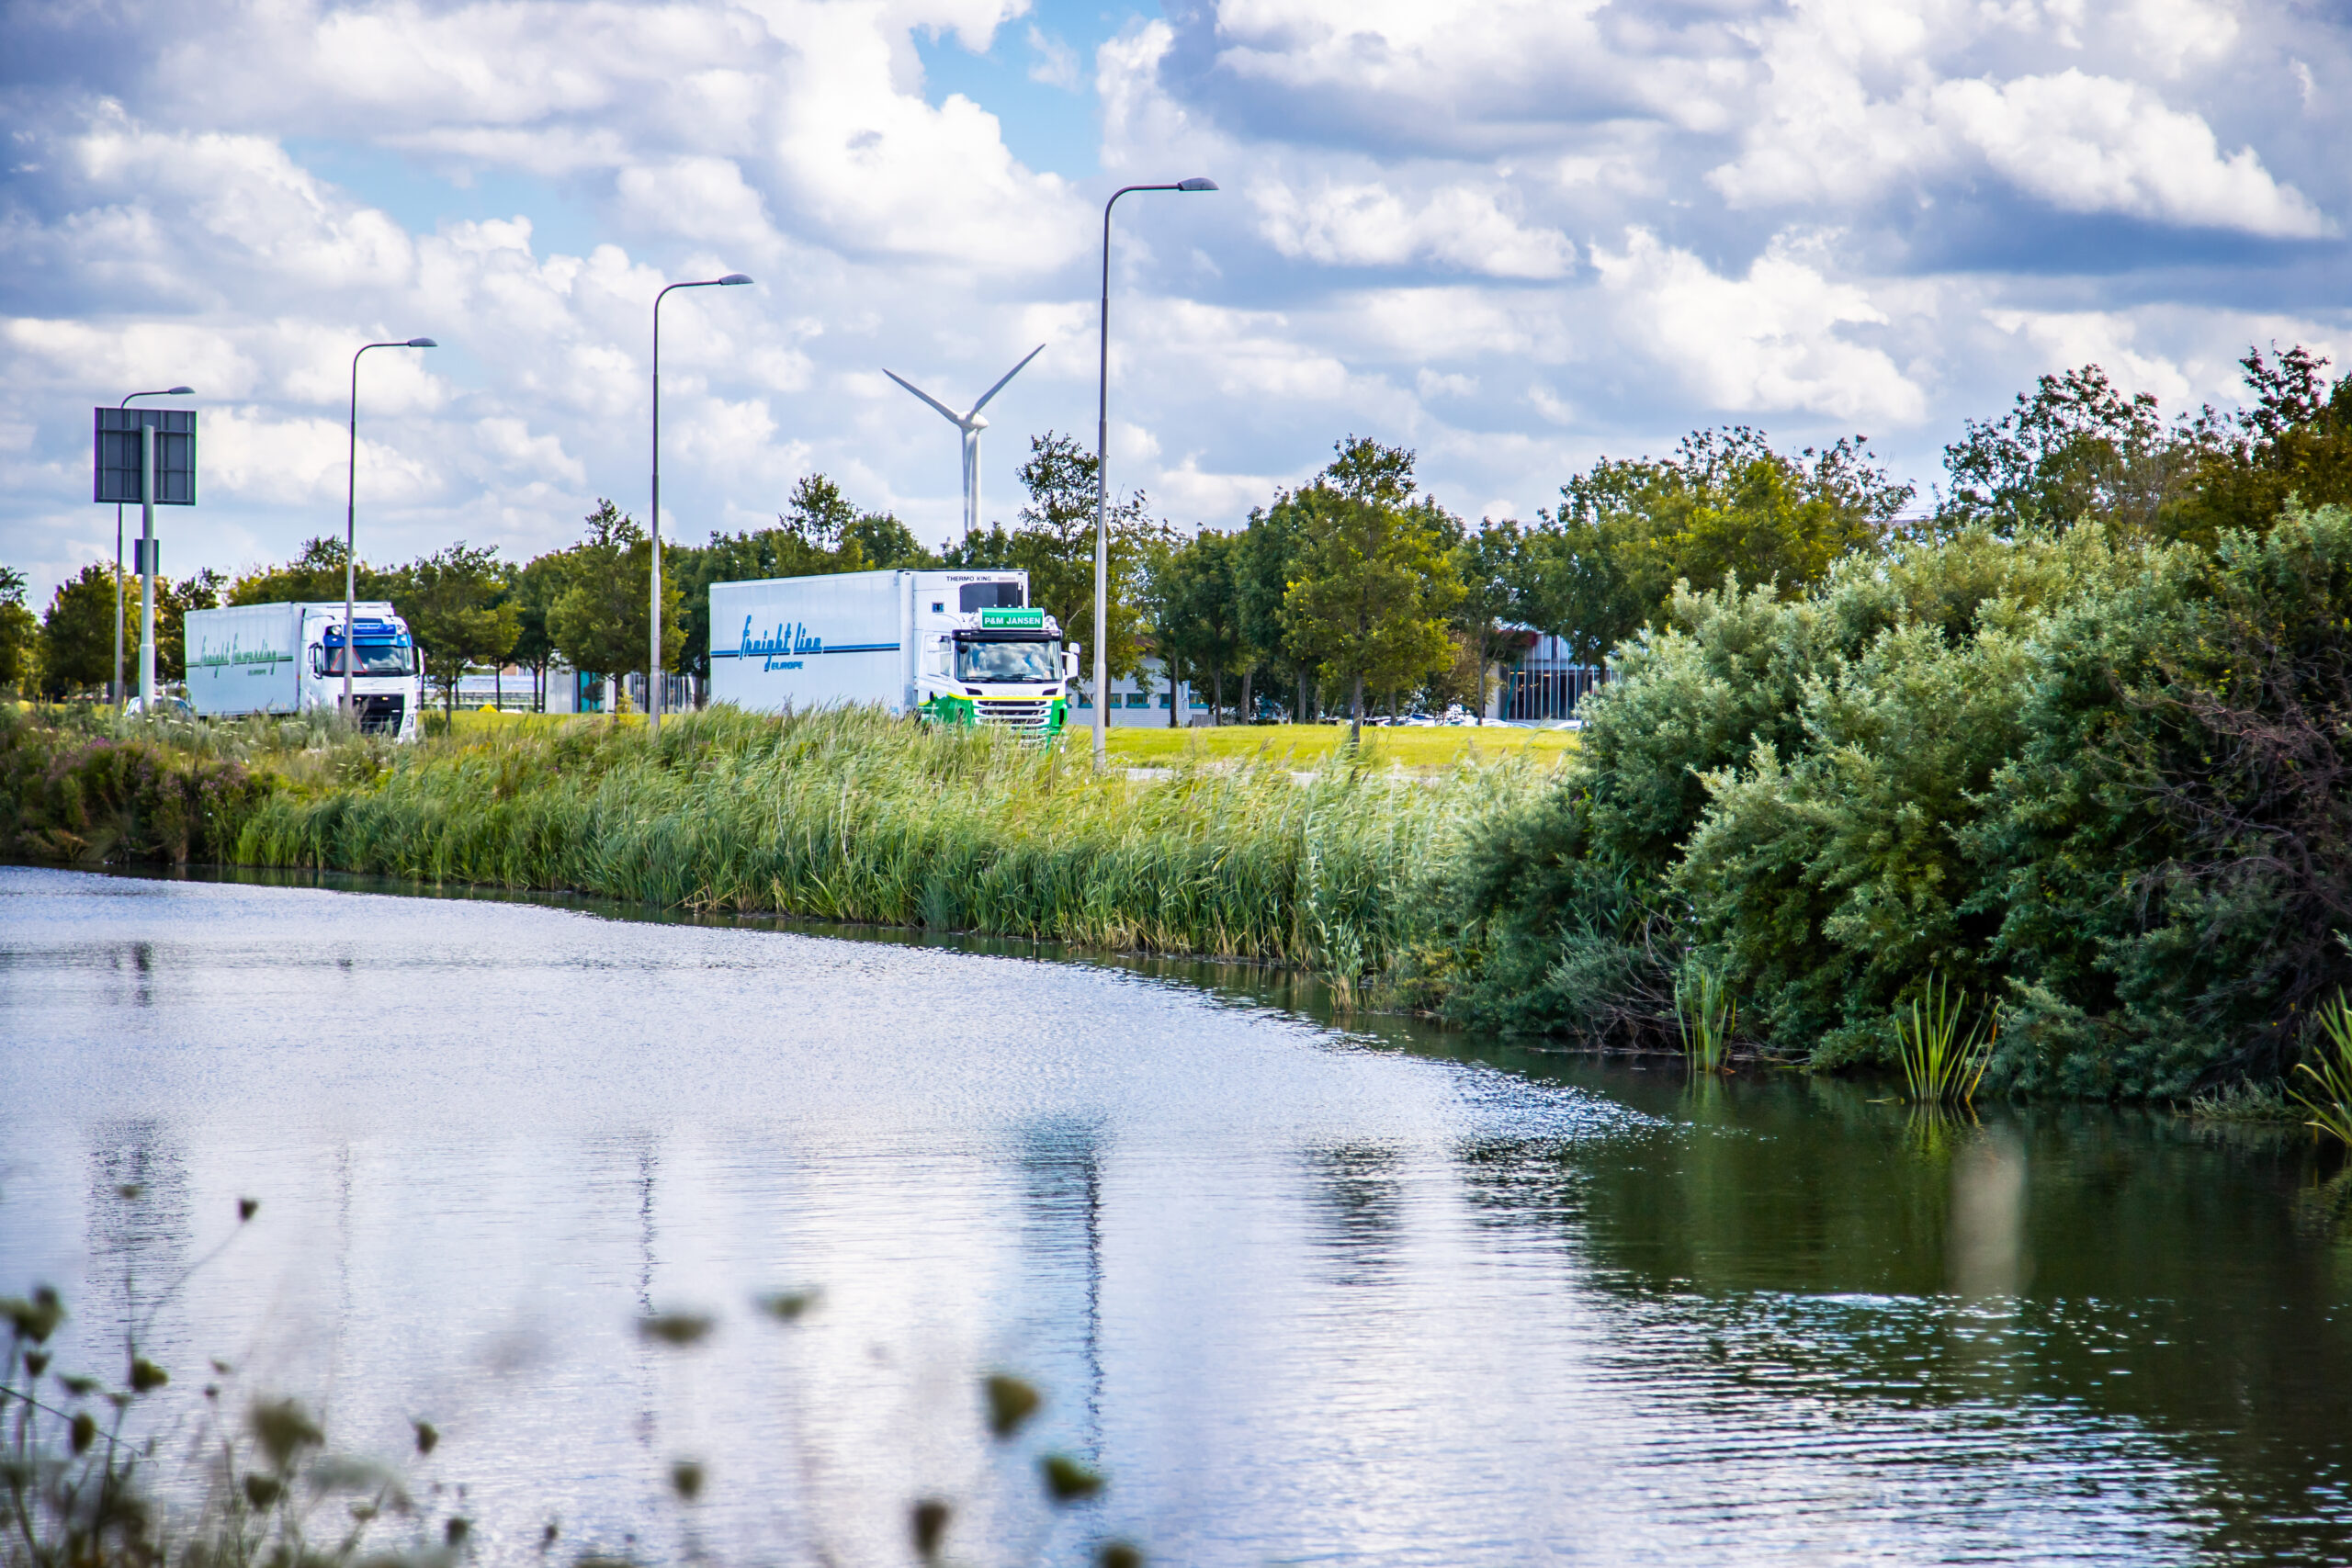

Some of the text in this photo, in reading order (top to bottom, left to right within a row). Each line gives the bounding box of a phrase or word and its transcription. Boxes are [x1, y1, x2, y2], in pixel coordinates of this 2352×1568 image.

[984, 616, 1041, 625] P&M JANSEN
[771, 661, 803, 671] EUROPE
